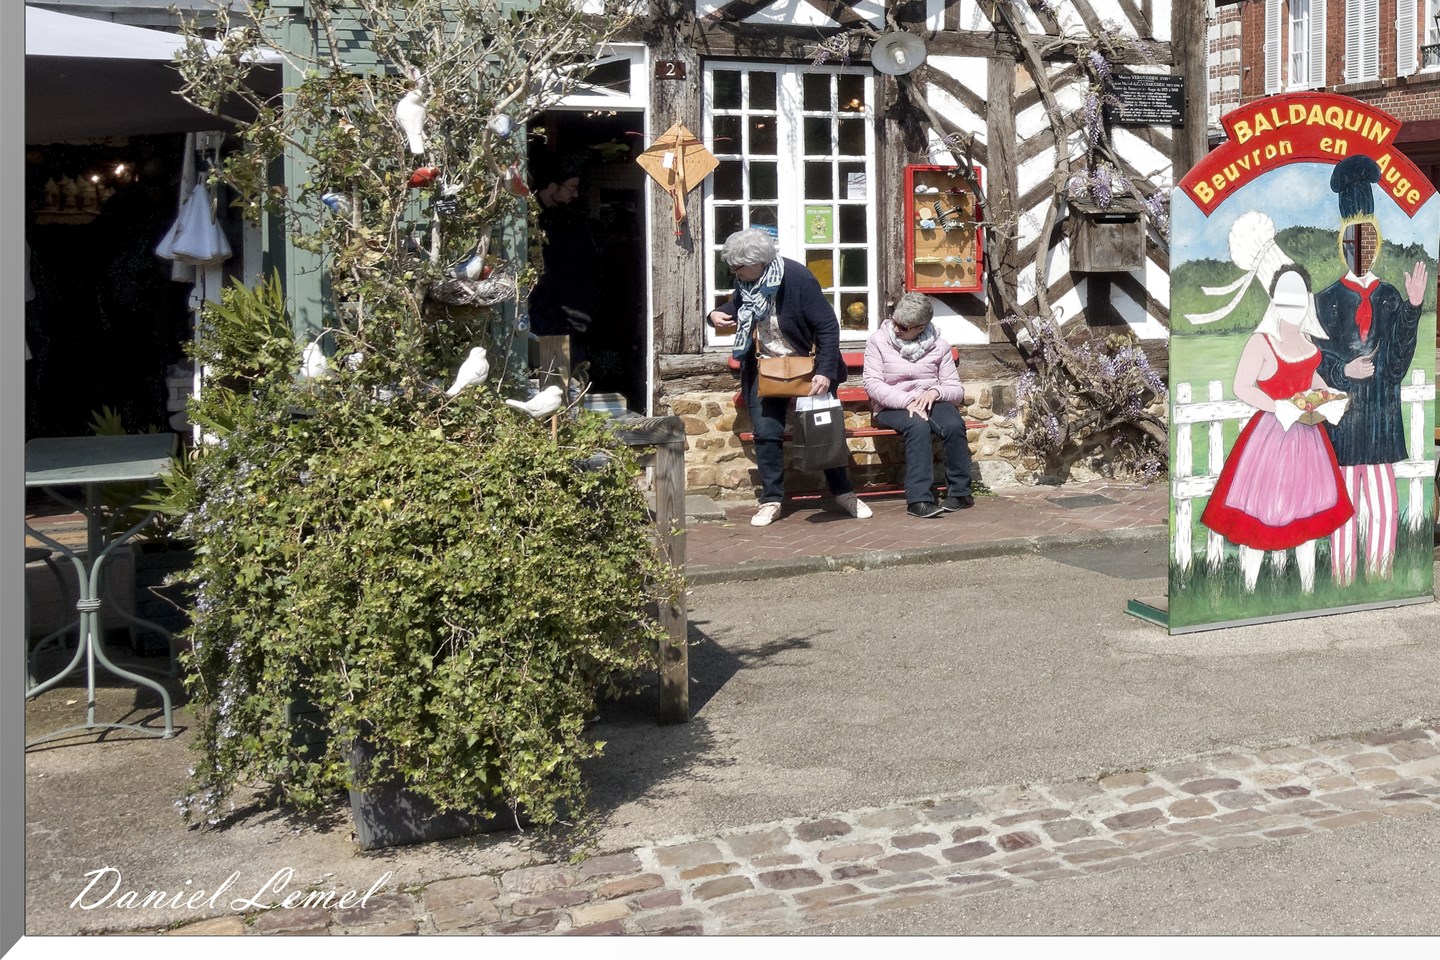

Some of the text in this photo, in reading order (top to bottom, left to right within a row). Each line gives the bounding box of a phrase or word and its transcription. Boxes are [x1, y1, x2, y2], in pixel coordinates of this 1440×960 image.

[665, 62, 676, 76] 2
[1234, 104, 1391, 144] BALDAQUIN
[1193, 137, 1421, 205] Beuvron en Auge
